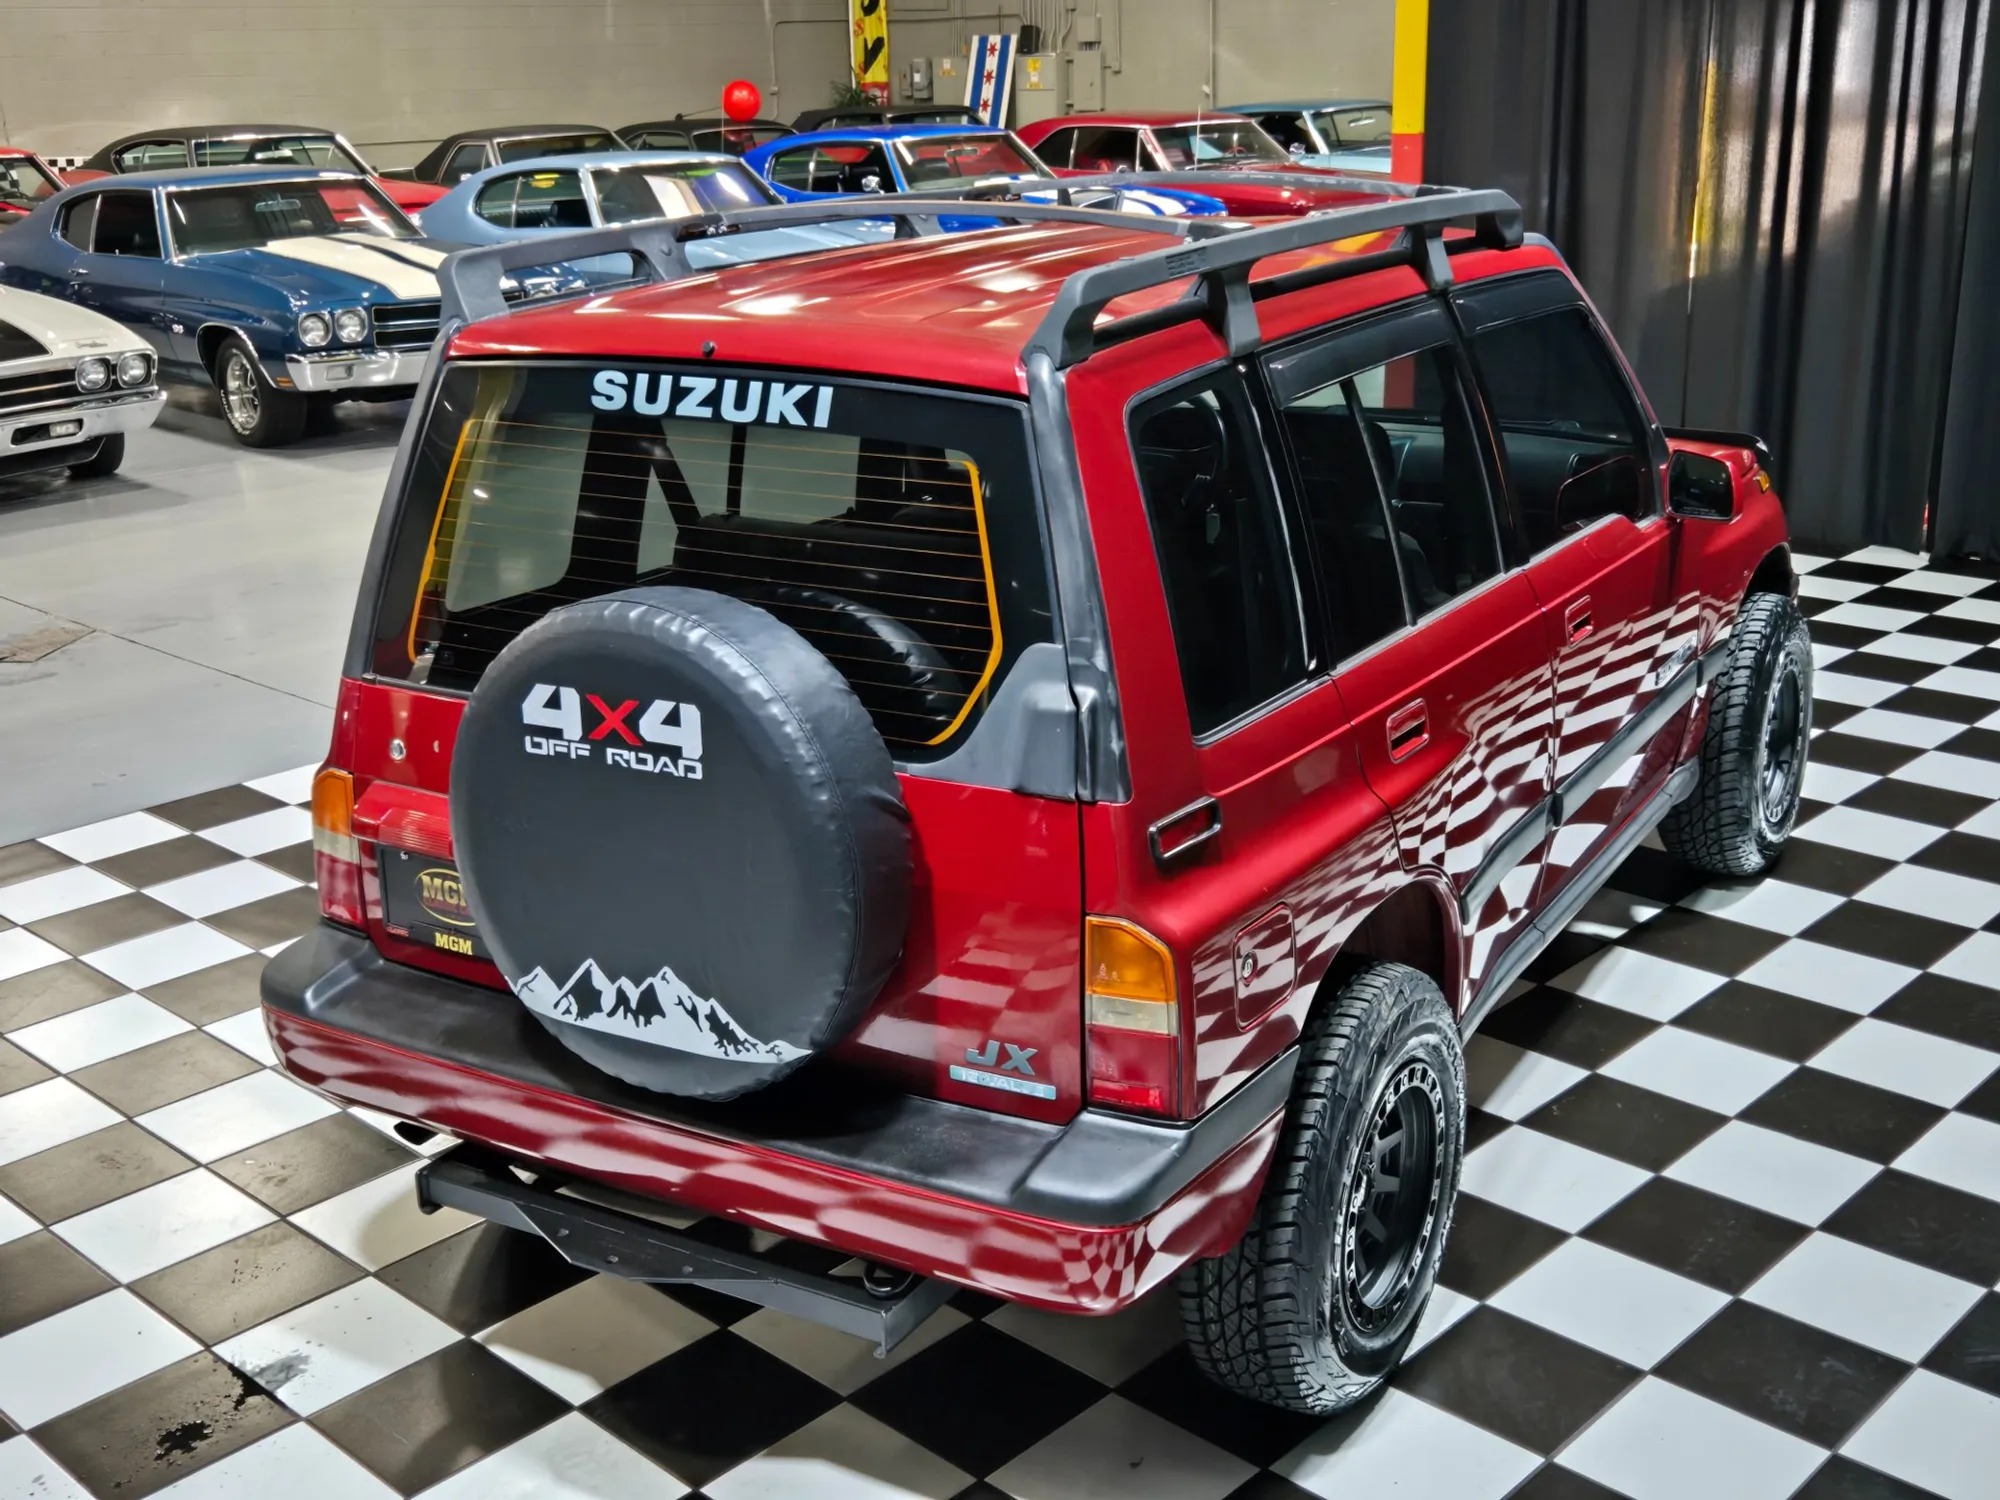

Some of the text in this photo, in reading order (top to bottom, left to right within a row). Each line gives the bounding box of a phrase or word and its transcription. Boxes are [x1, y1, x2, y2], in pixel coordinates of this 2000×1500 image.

[590, 370, 834, 429] SUZUKI
[525, 735, 703, 780] OFF ROAD
[435, 932, 473, 956] MGM
[965, 1039, 1039, 1076] JX
